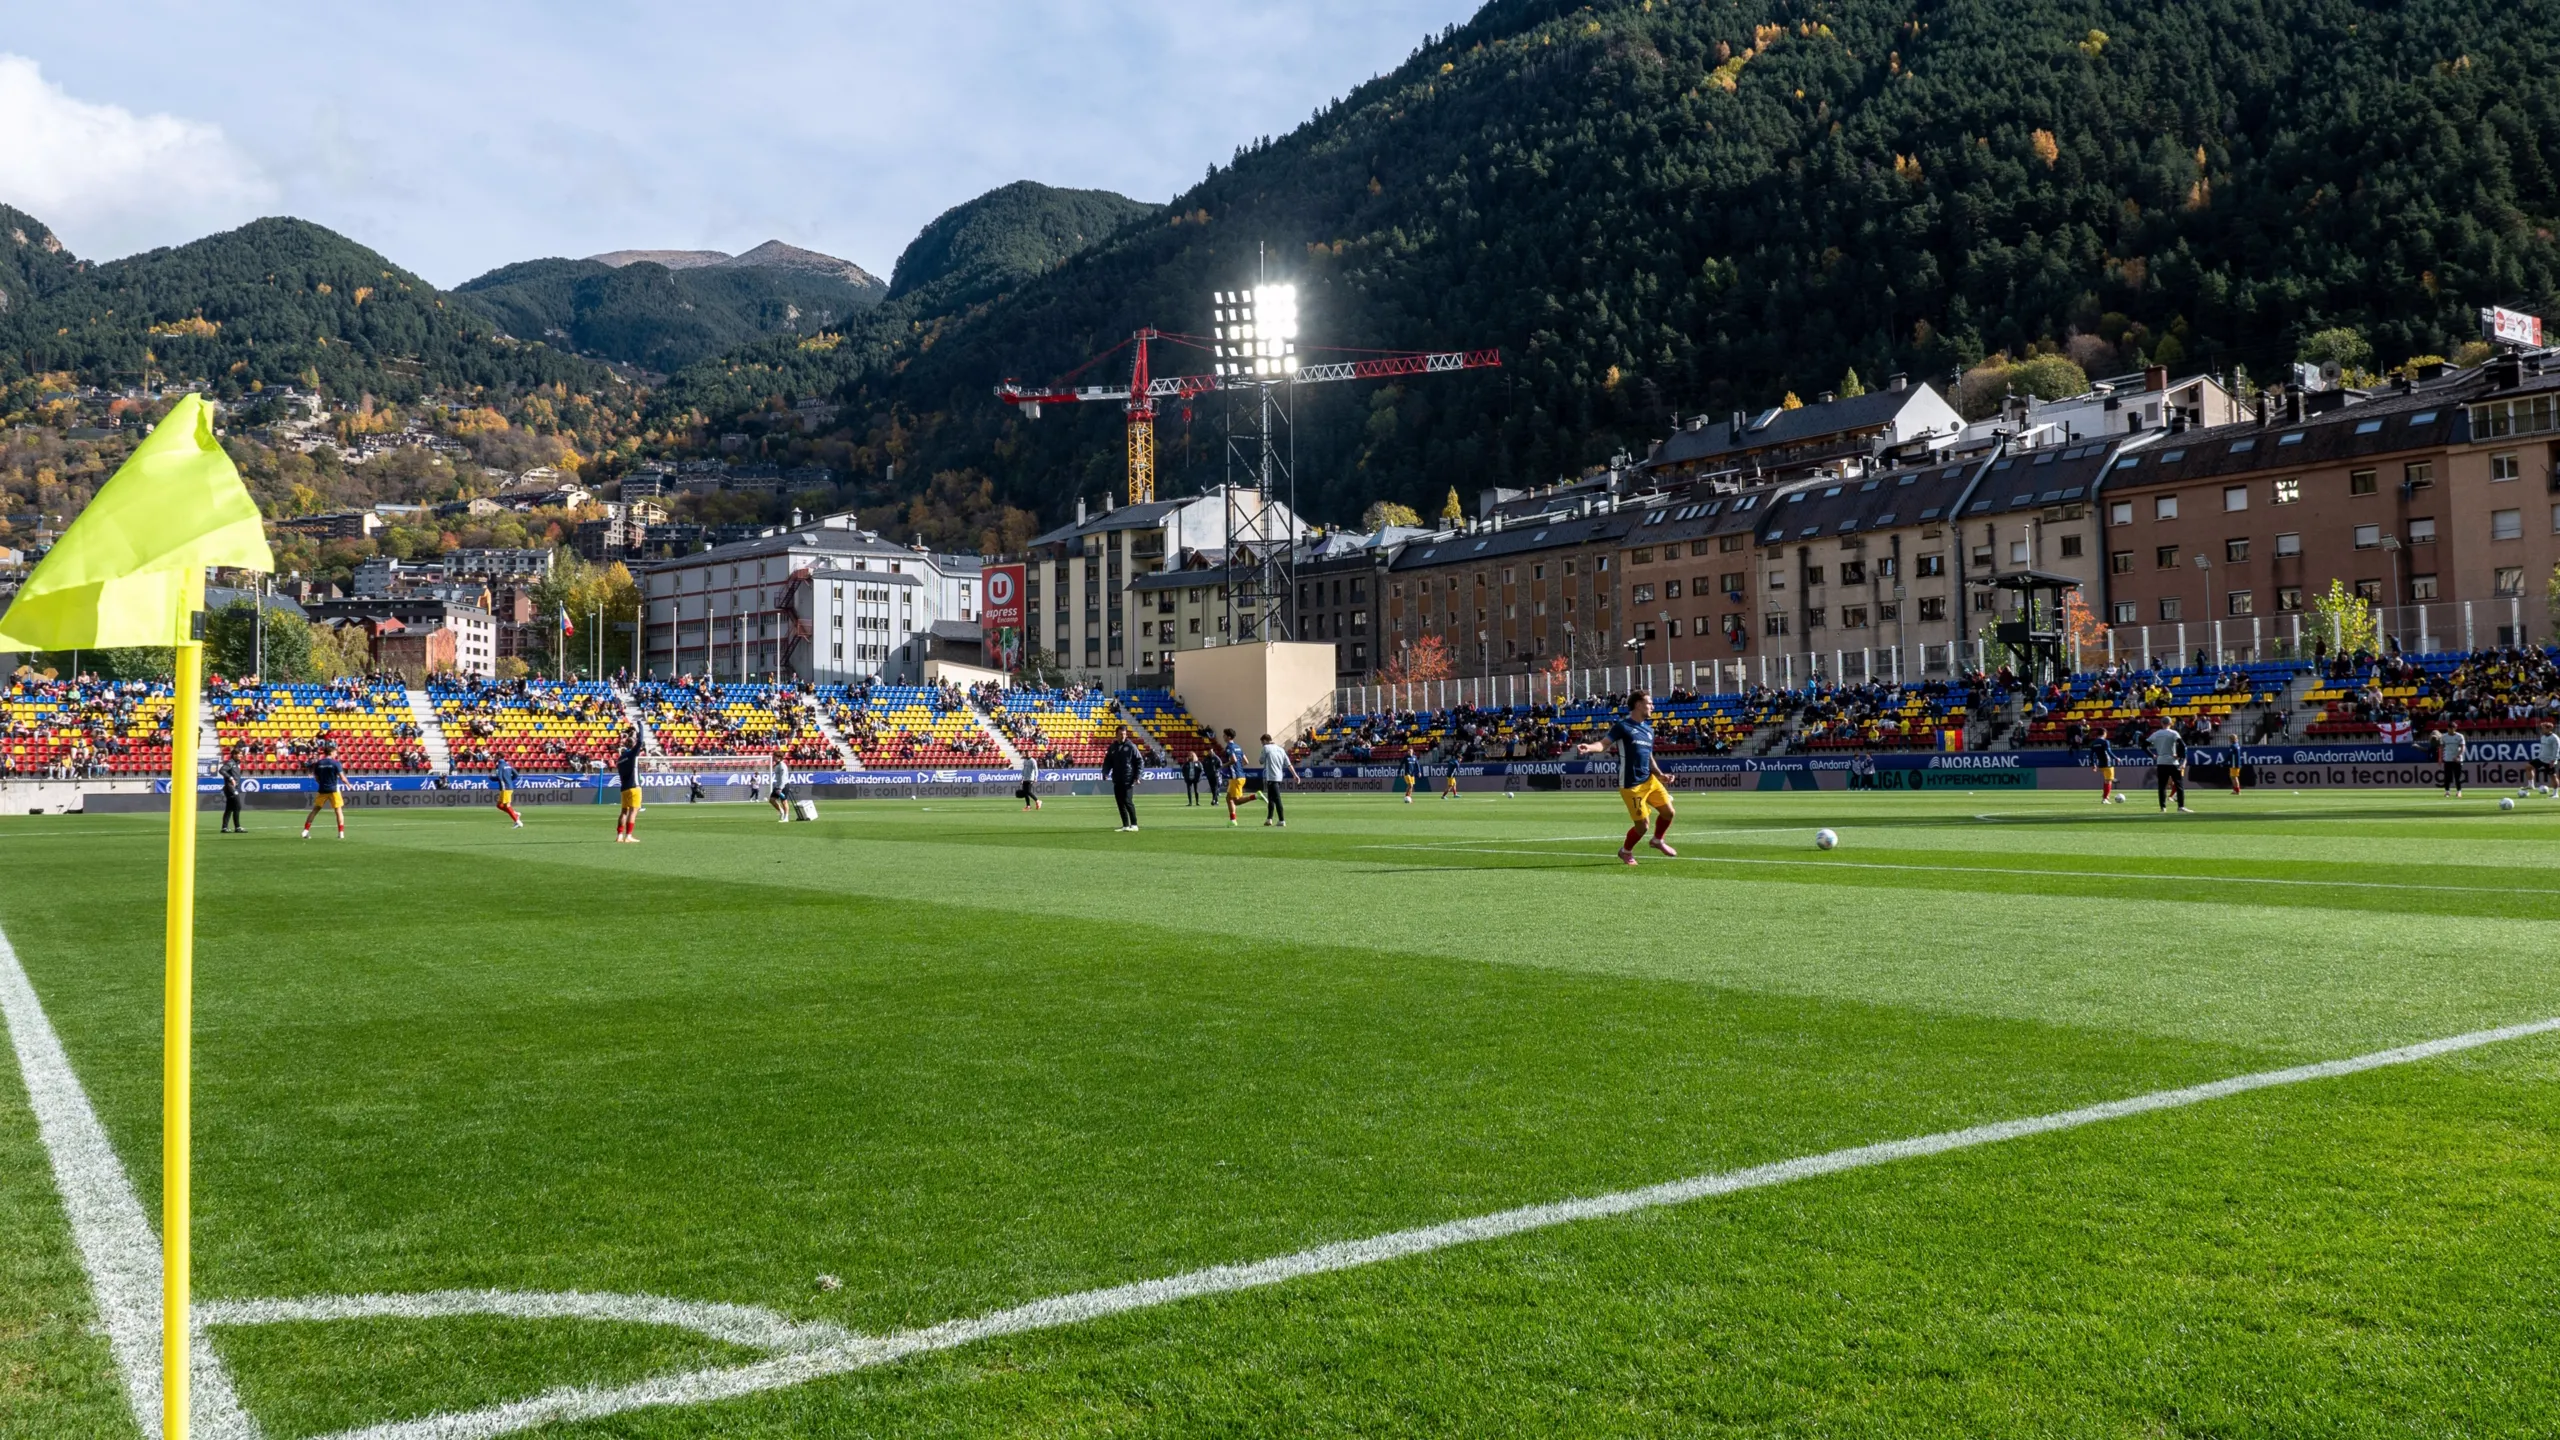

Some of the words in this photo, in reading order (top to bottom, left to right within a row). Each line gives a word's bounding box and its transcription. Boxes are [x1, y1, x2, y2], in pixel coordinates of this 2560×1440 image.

[993, 580, 1007, 598] U
[986, 607, 1018, 619] express
[997, 616, 1018, 624] Encamp
[2293, 749, 2394, 763] @AndorraWorld
[2464, 743, 2541, 760] MORAB
[1670, 762, 1740, 772] visitandorra.com
[1760, 760, 1803, 771] Andorra
[1809, 759, 1851, 771] @Andorra
[1941, 755, 2020, 768] MORABANC
[1513, 763, 1567, 775] MORABANC
[835, 773, 912, 785] visitandorra.com
[1575, 778, 1594, 788] con
[1596, 775, 1606, 788] la
[1694, 773, 1742, 788] mundial
[1926, 773, 2021, 786] HYPERMOTION
[2283, 770, 2320, 785] con
[2327, 766, 2345, 785] la
[2351, 765, 2469, 788] tecnologa
[522, 779, 582, 789] AnvósPark
[878, 786, 898, 797] con
[901, 784, 912, 796] la
[916, 783, 979, 798] tecnología
[982, 782, 1008, 795] líder
[1352, 778, 1383, 790] mundial
[366, 792, 380, 806] la
[392, 790, 471, 808] tecnología
[513, 789, 573, 803] mundial
